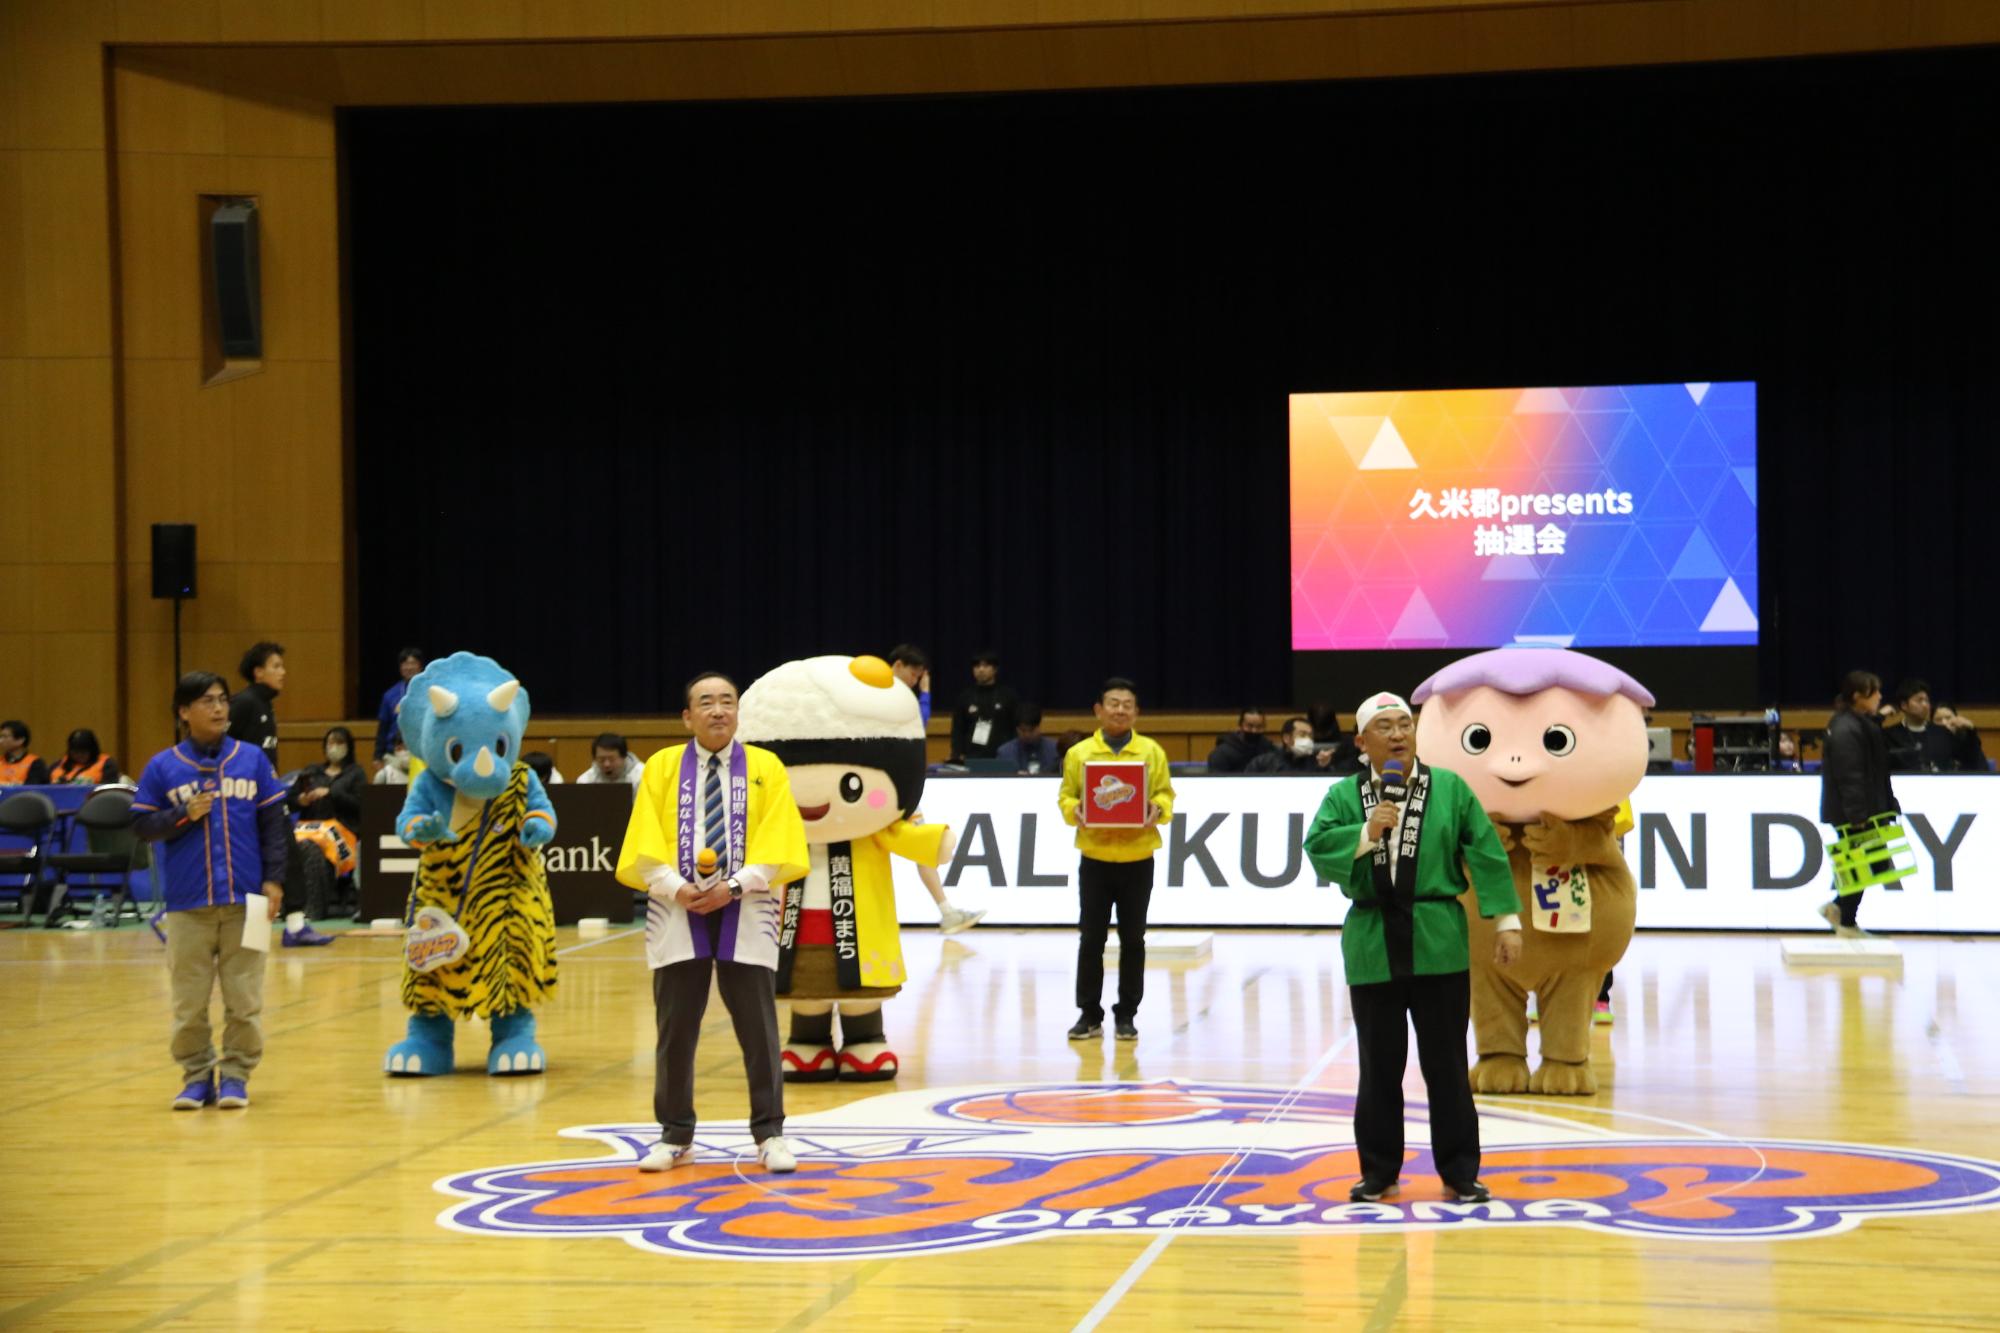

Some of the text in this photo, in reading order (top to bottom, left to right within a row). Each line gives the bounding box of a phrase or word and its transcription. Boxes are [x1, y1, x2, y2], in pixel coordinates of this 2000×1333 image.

[1408, 487, 1634, 522] 久米郡presents
[1473, 523, 1567, 557] 抽選会
[680, 779, 695, 876] くめなんちょう
[732, 776, 746, 872] 岡山県 久米南町
[1400, 774, 1429, 858] 岡山県 美咲町
[536, 836, 614, 873] ank
[780, 887, 802, 949] 美咲町
[830, 855, 856, 960] 黄福のまち
[972, 1198, 1616, 1231] OKAYAMA
